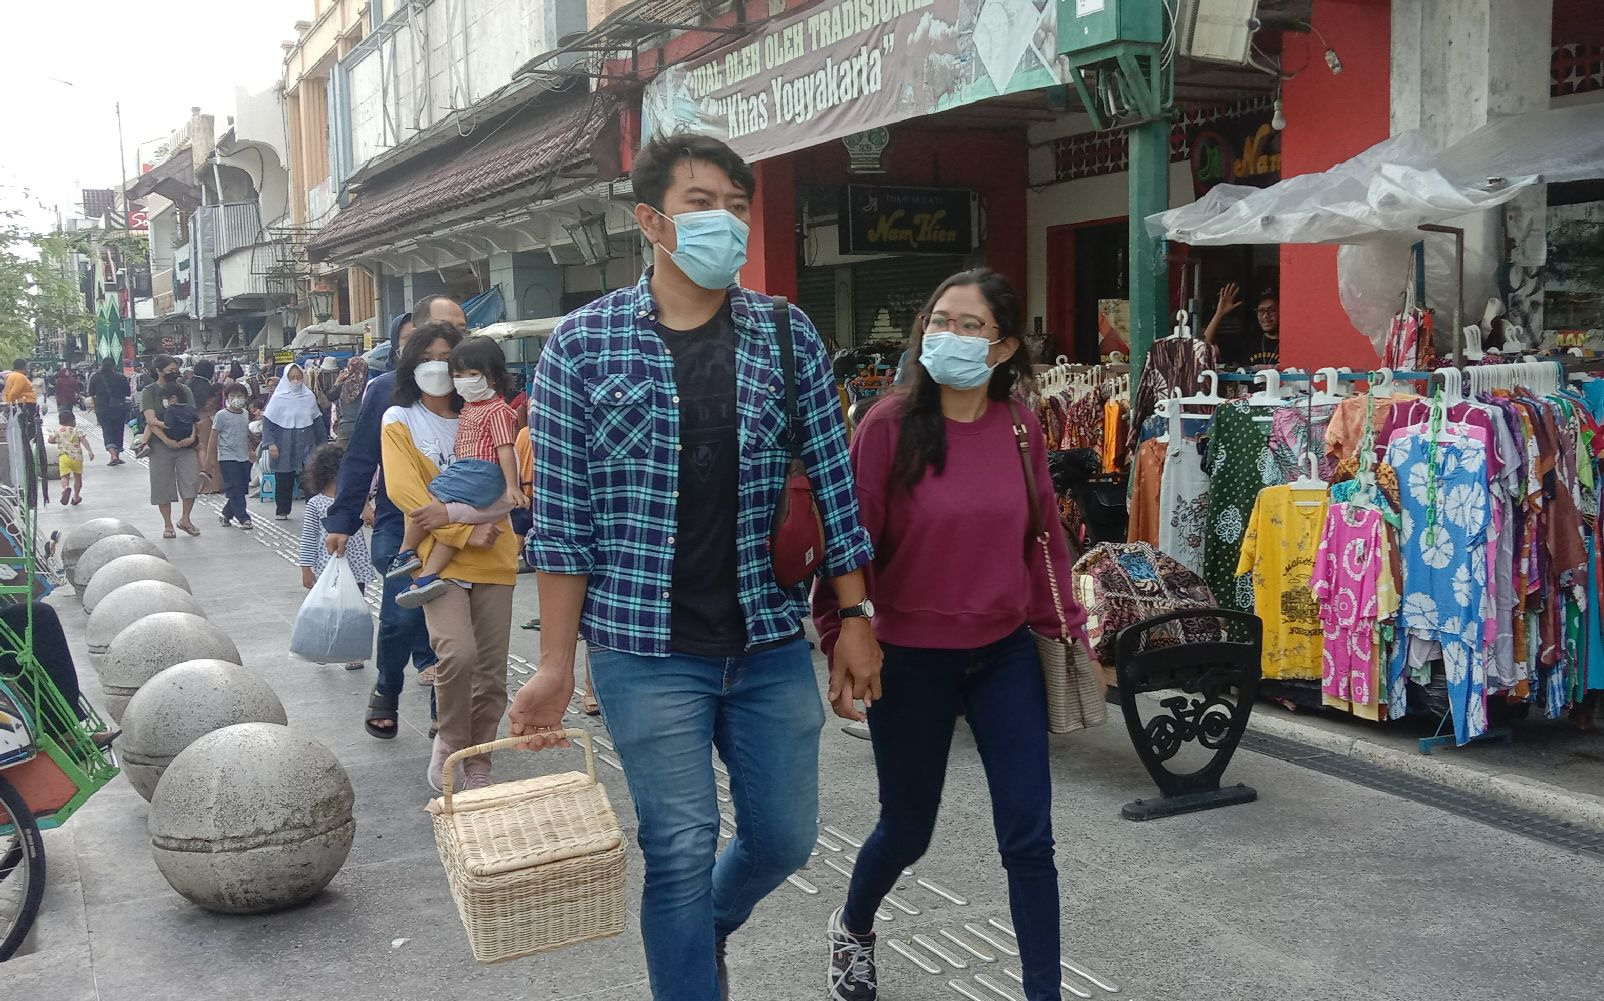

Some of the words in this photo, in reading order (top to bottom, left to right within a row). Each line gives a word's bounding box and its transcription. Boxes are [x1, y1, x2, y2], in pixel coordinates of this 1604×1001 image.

[725, 41, 760, 86] OLEH
[764, 21, 805, 70] OLEH
[807, 0, 934, 52] TRADISION
[867, 208, 918, 248] Nam
